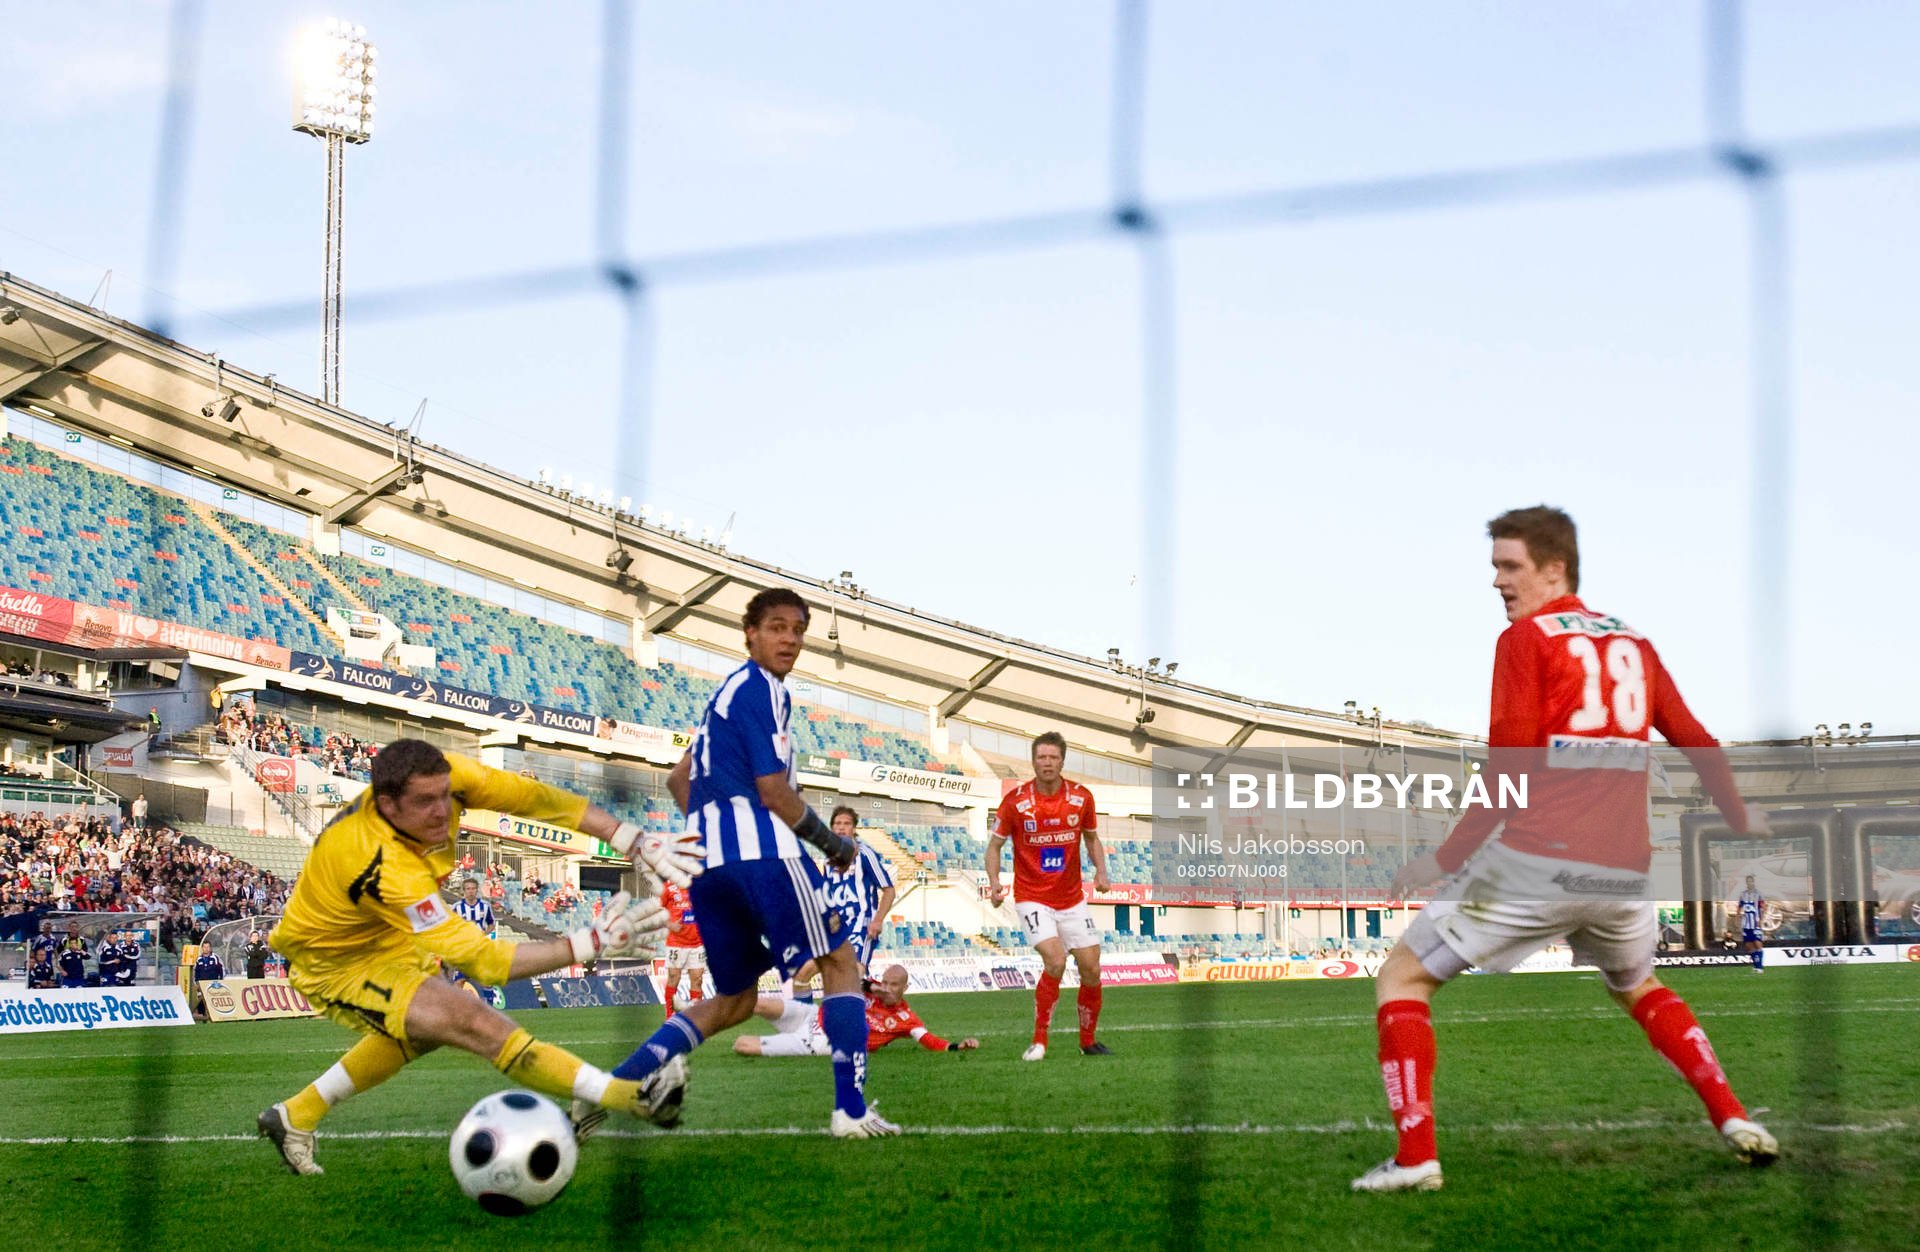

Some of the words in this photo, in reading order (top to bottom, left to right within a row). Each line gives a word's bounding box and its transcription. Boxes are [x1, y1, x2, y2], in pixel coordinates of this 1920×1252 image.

[159, 624, 243, 660] återvinning
[255, 655, 282, 669] Renova
[343, 666, 392, 690] FALCON
[1567, 635, 1648, 734] 18
[444, 690, 490, 712] FALCON
[543, 711, 592, 733] FALCON
[889, 771, 936, 790] Göteborg
[939, 777, 972, 793] Energi
[514, 821, 573, 845] TULIP
[1029, 834, 1053, 843] AUDIO
[1054, 832, 1075, 842] VIDEO
[1044, 857, 1063, 867] SAS
[1025, 910, 1039, 931] 17
[1650, 955, 1753, 966] OLVOFINAN
[1782, 947, 1876, 958] VOLVIA
[1206, 963, 1291, 981] GUUULD!
[363, 980, 392, 1002] 1
[0, 995, 178, 1028] Göteborgs-Posten
